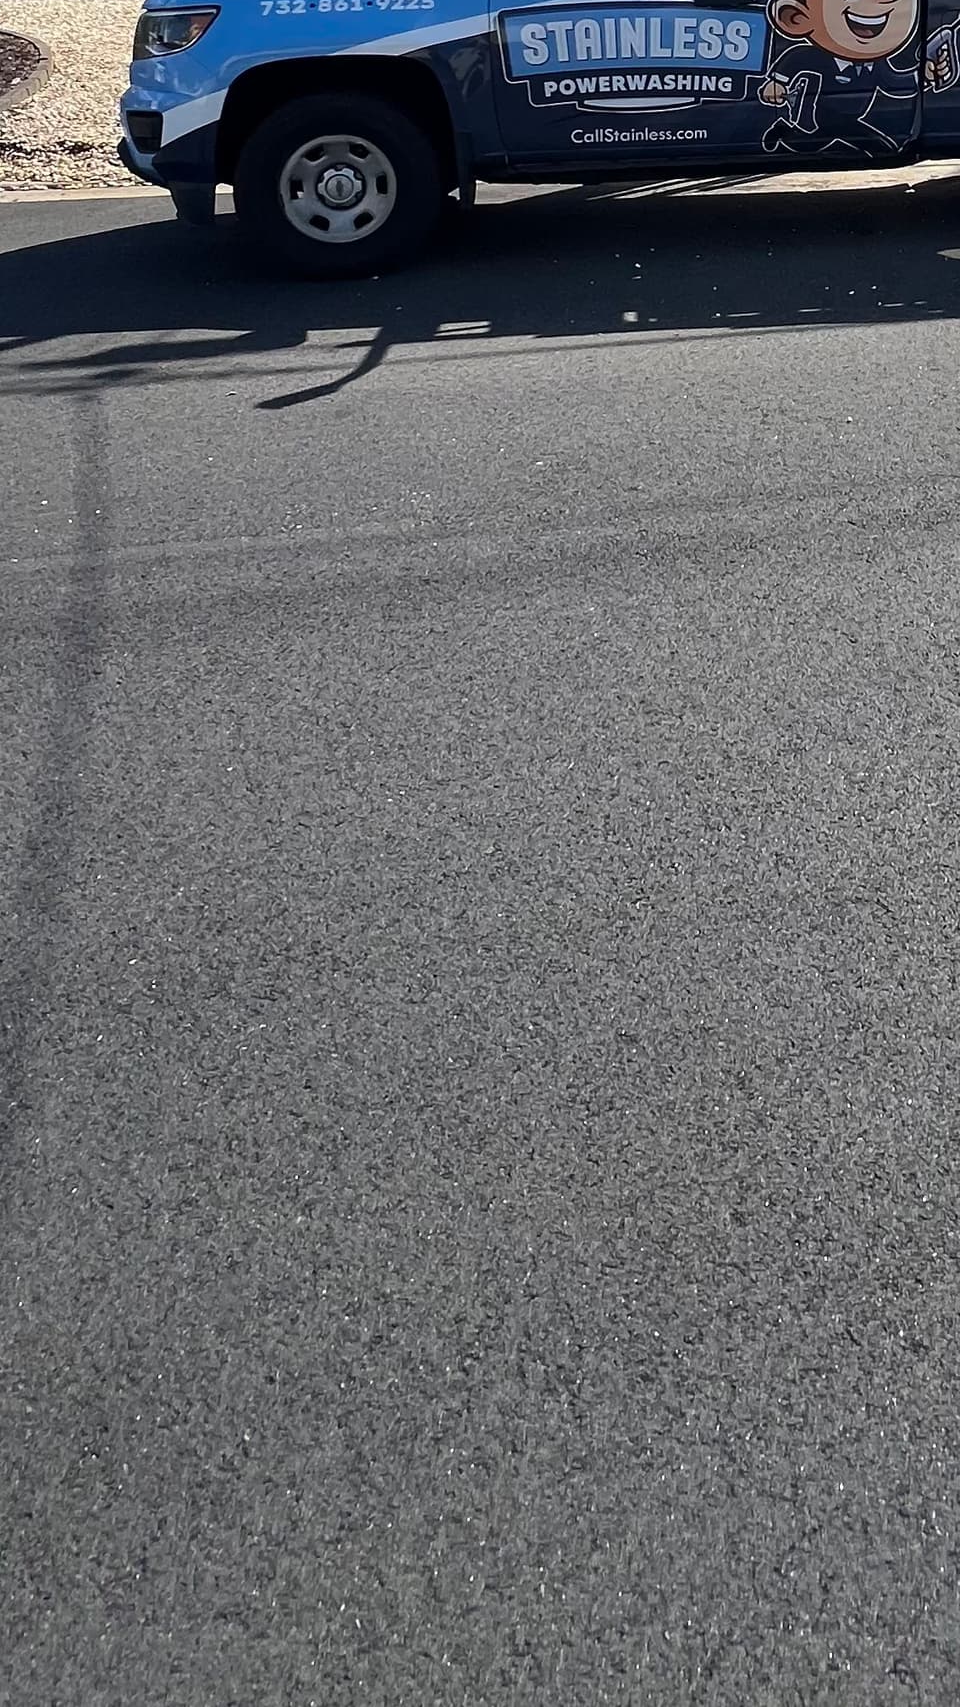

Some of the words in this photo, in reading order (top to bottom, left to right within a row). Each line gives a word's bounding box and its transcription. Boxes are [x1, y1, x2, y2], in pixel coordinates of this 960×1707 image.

[520, 17, 751, 66] STAINLESS
[543, 74, 733, 97] POWERWASHING
[570, 127, 708, 144] CallStainless.com
